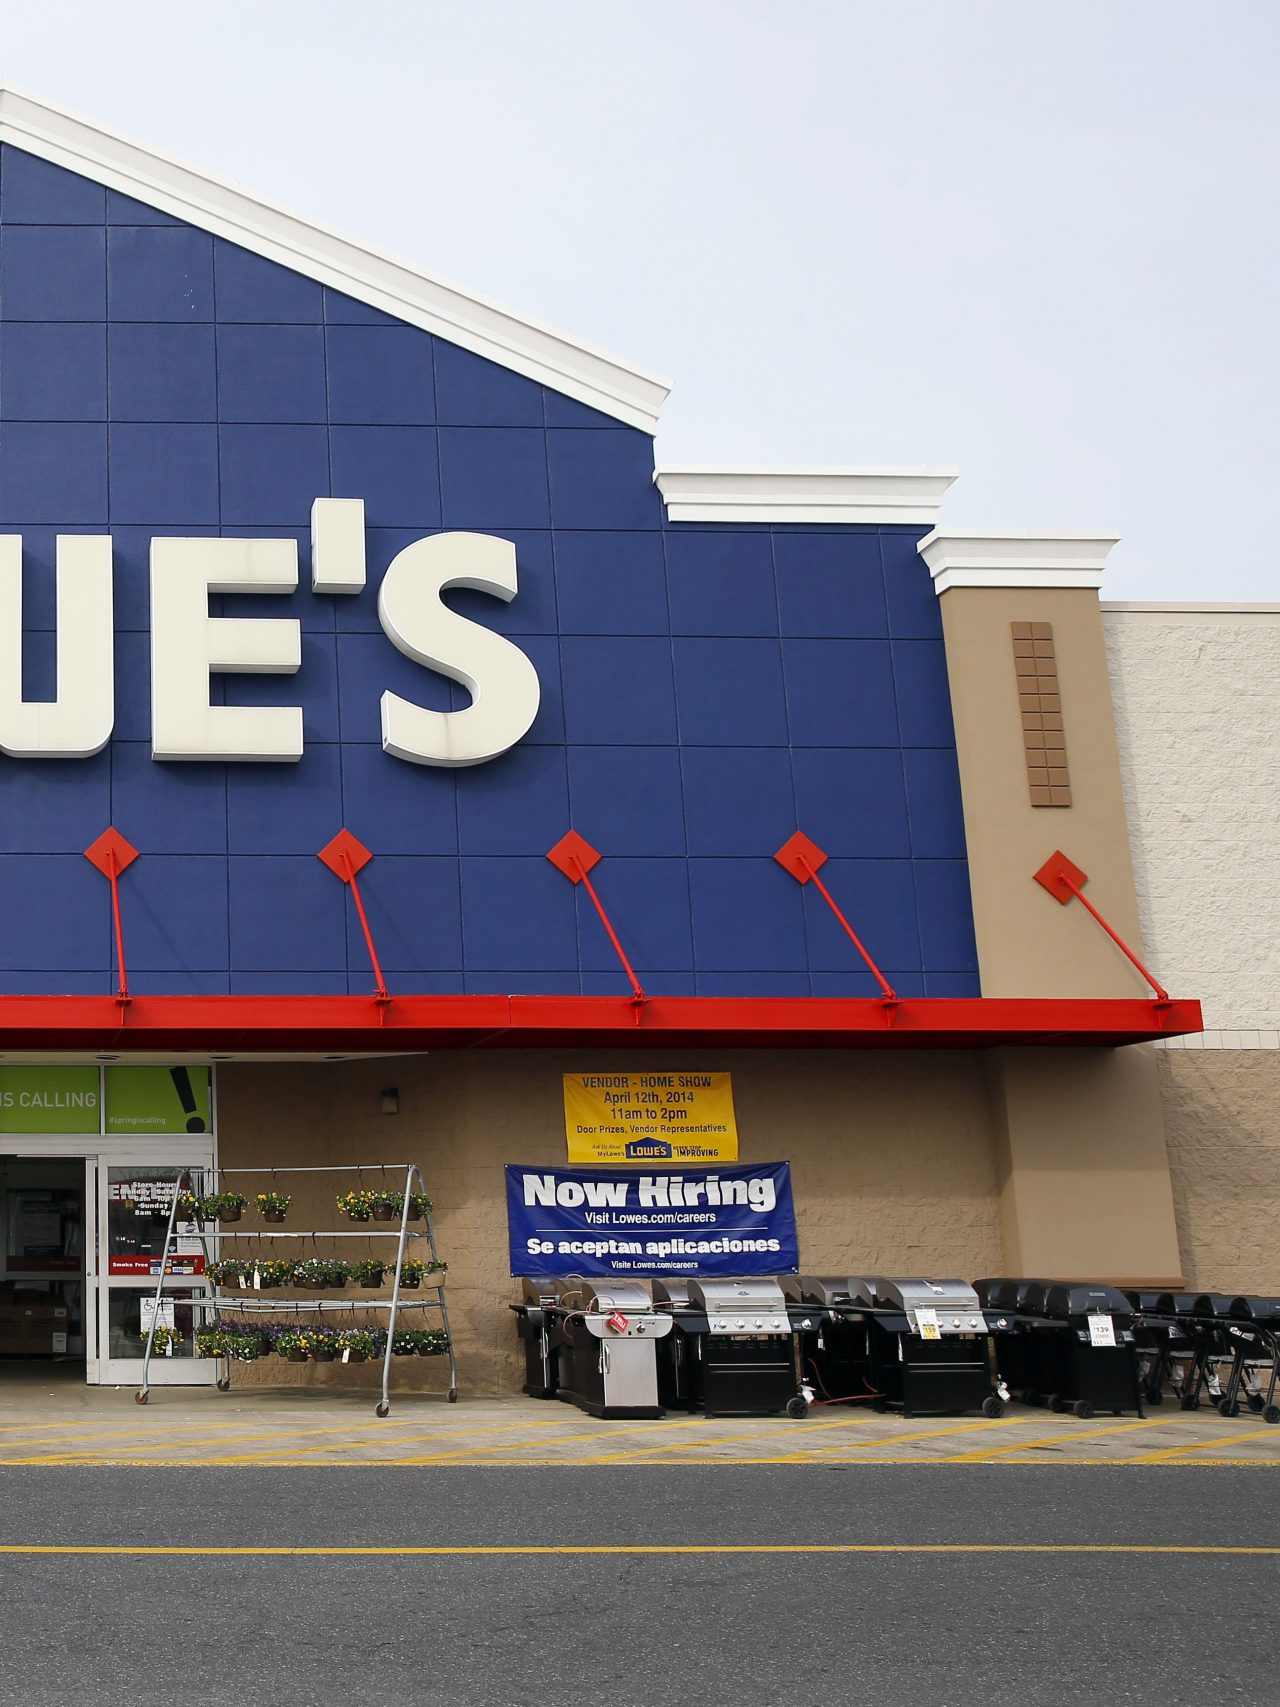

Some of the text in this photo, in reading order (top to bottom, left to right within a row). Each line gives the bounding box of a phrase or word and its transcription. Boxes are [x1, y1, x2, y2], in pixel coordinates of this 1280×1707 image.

[583, 1077, 628, 1088] VENDOR
[641, 1076, 674, 1088] HOME
[678, 1076, 712, 1087] SHOW
[0, 1092, 14, 1107] IS
[20, 1092, 96, 1107] CALLING
[604, 1092, 694, 1106] April 12th, 2014
[109, 1116, 166, 1125] #springiscalling
[611, 1108, 687, 1122] 11am to 2pm
[577, 1124, 727, 1134] Door Prizes, Vendor Representatives
[630, 1145, 667, 1156] LOWE'S
[677, 1149, 719, 1157] IMPROVING
[523, 1175, 776, 1213] Now Hiring
[584, 1212, 716, 1225] Visit Lowes.com/careers
[527, 1238, 781, 1258] Se aceptan aplicaciones
[611, 1260, 698, 1269] Visite Lowes.com/careers
